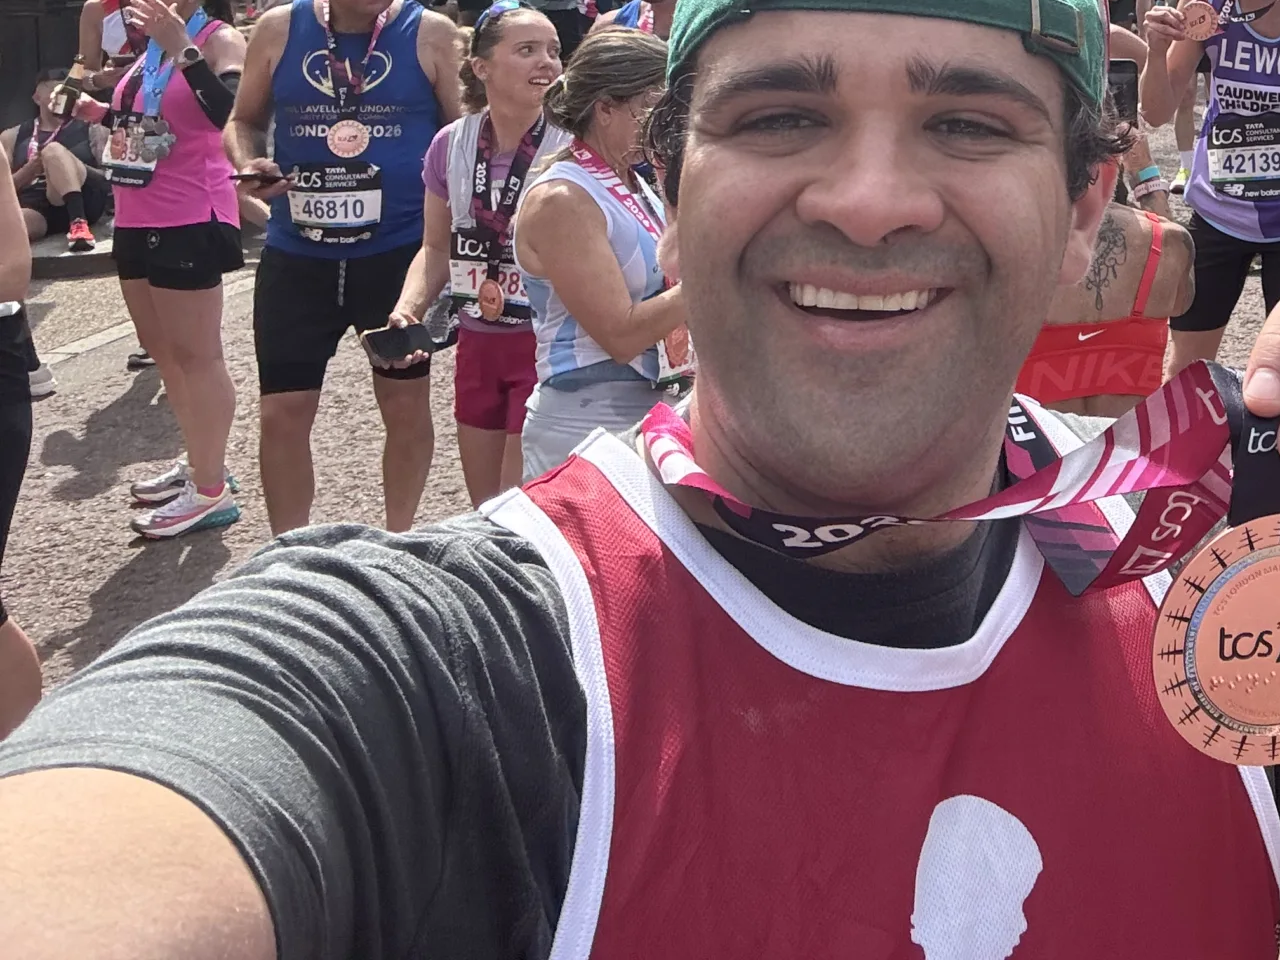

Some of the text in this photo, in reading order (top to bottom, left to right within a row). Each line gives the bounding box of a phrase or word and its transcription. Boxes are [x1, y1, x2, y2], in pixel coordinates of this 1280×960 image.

[289, 123, 402, 138] LOND 2026
[1211, 124, 1243, 146] tcs
[1244, 122, 1265, 130] TATA
[1245, 134, 1275, 143] SERVICES
[324, 166, 347, 175] TATA
[475, 161, 487, 194] 2026
[324, 179, 358, 189] SERVICES
[1244, 189, 1259, 198] new
[302, 198, 365, 220] 46810
[456, 232, 489, 258] tc
[1028, 351, 1163, 398] NIKE
[1247, 427, 1277, 454] tc
[1151, 491, 1209, 542] tcs
[772, 515, 925, 549] 202
[1213, 599, 1229, 617] TCS
[1227, 569, 1263, 600] LONDON
[1218, 626, 1273, 662] tcs
